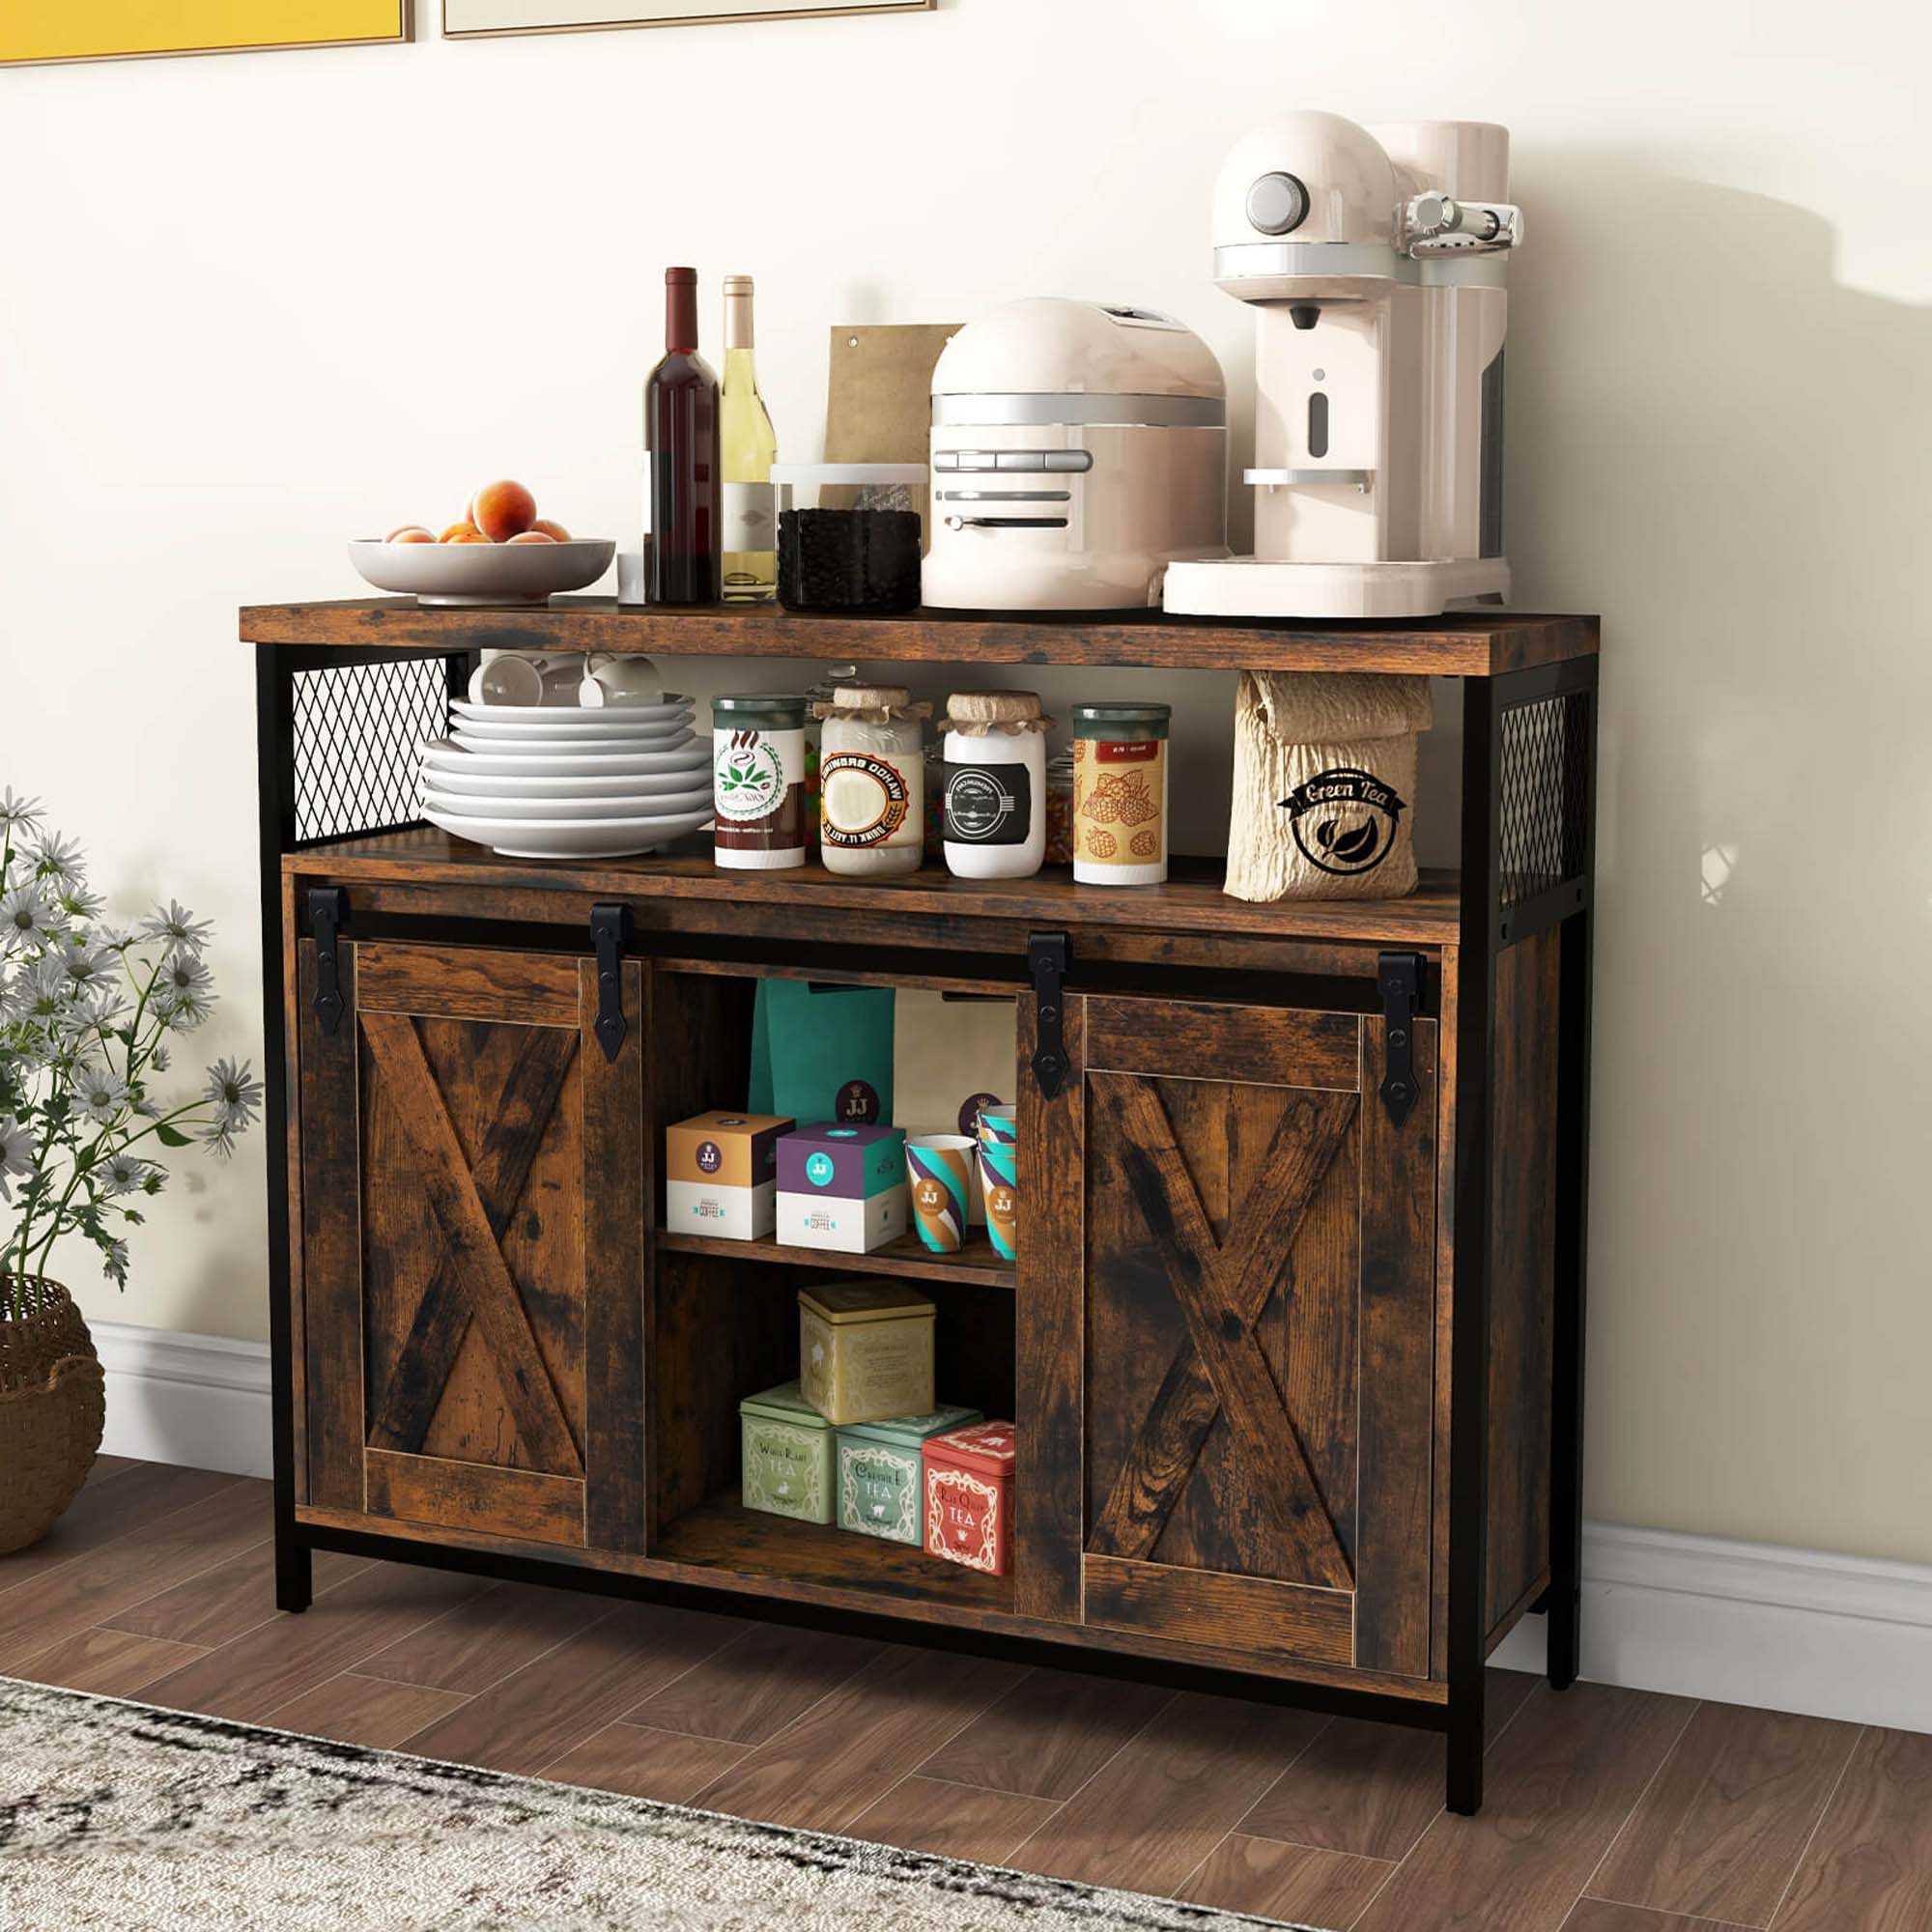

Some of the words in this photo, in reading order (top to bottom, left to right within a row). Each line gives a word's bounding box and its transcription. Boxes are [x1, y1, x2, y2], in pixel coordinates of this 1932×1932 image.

[1306, 783, 1353, 803] Green
[1361, 781, 1388, 805] Tea
[846, 1097, 867, 1117] JJ
[701, 1152, 715, 1163] JJ
[921, 1191, 938, 1204] JJ
[994, 1198, 1012, 1211] JJ
[866, 1481, 893, 1499] TEA
[950, 1506, 975, 1527] TEA
